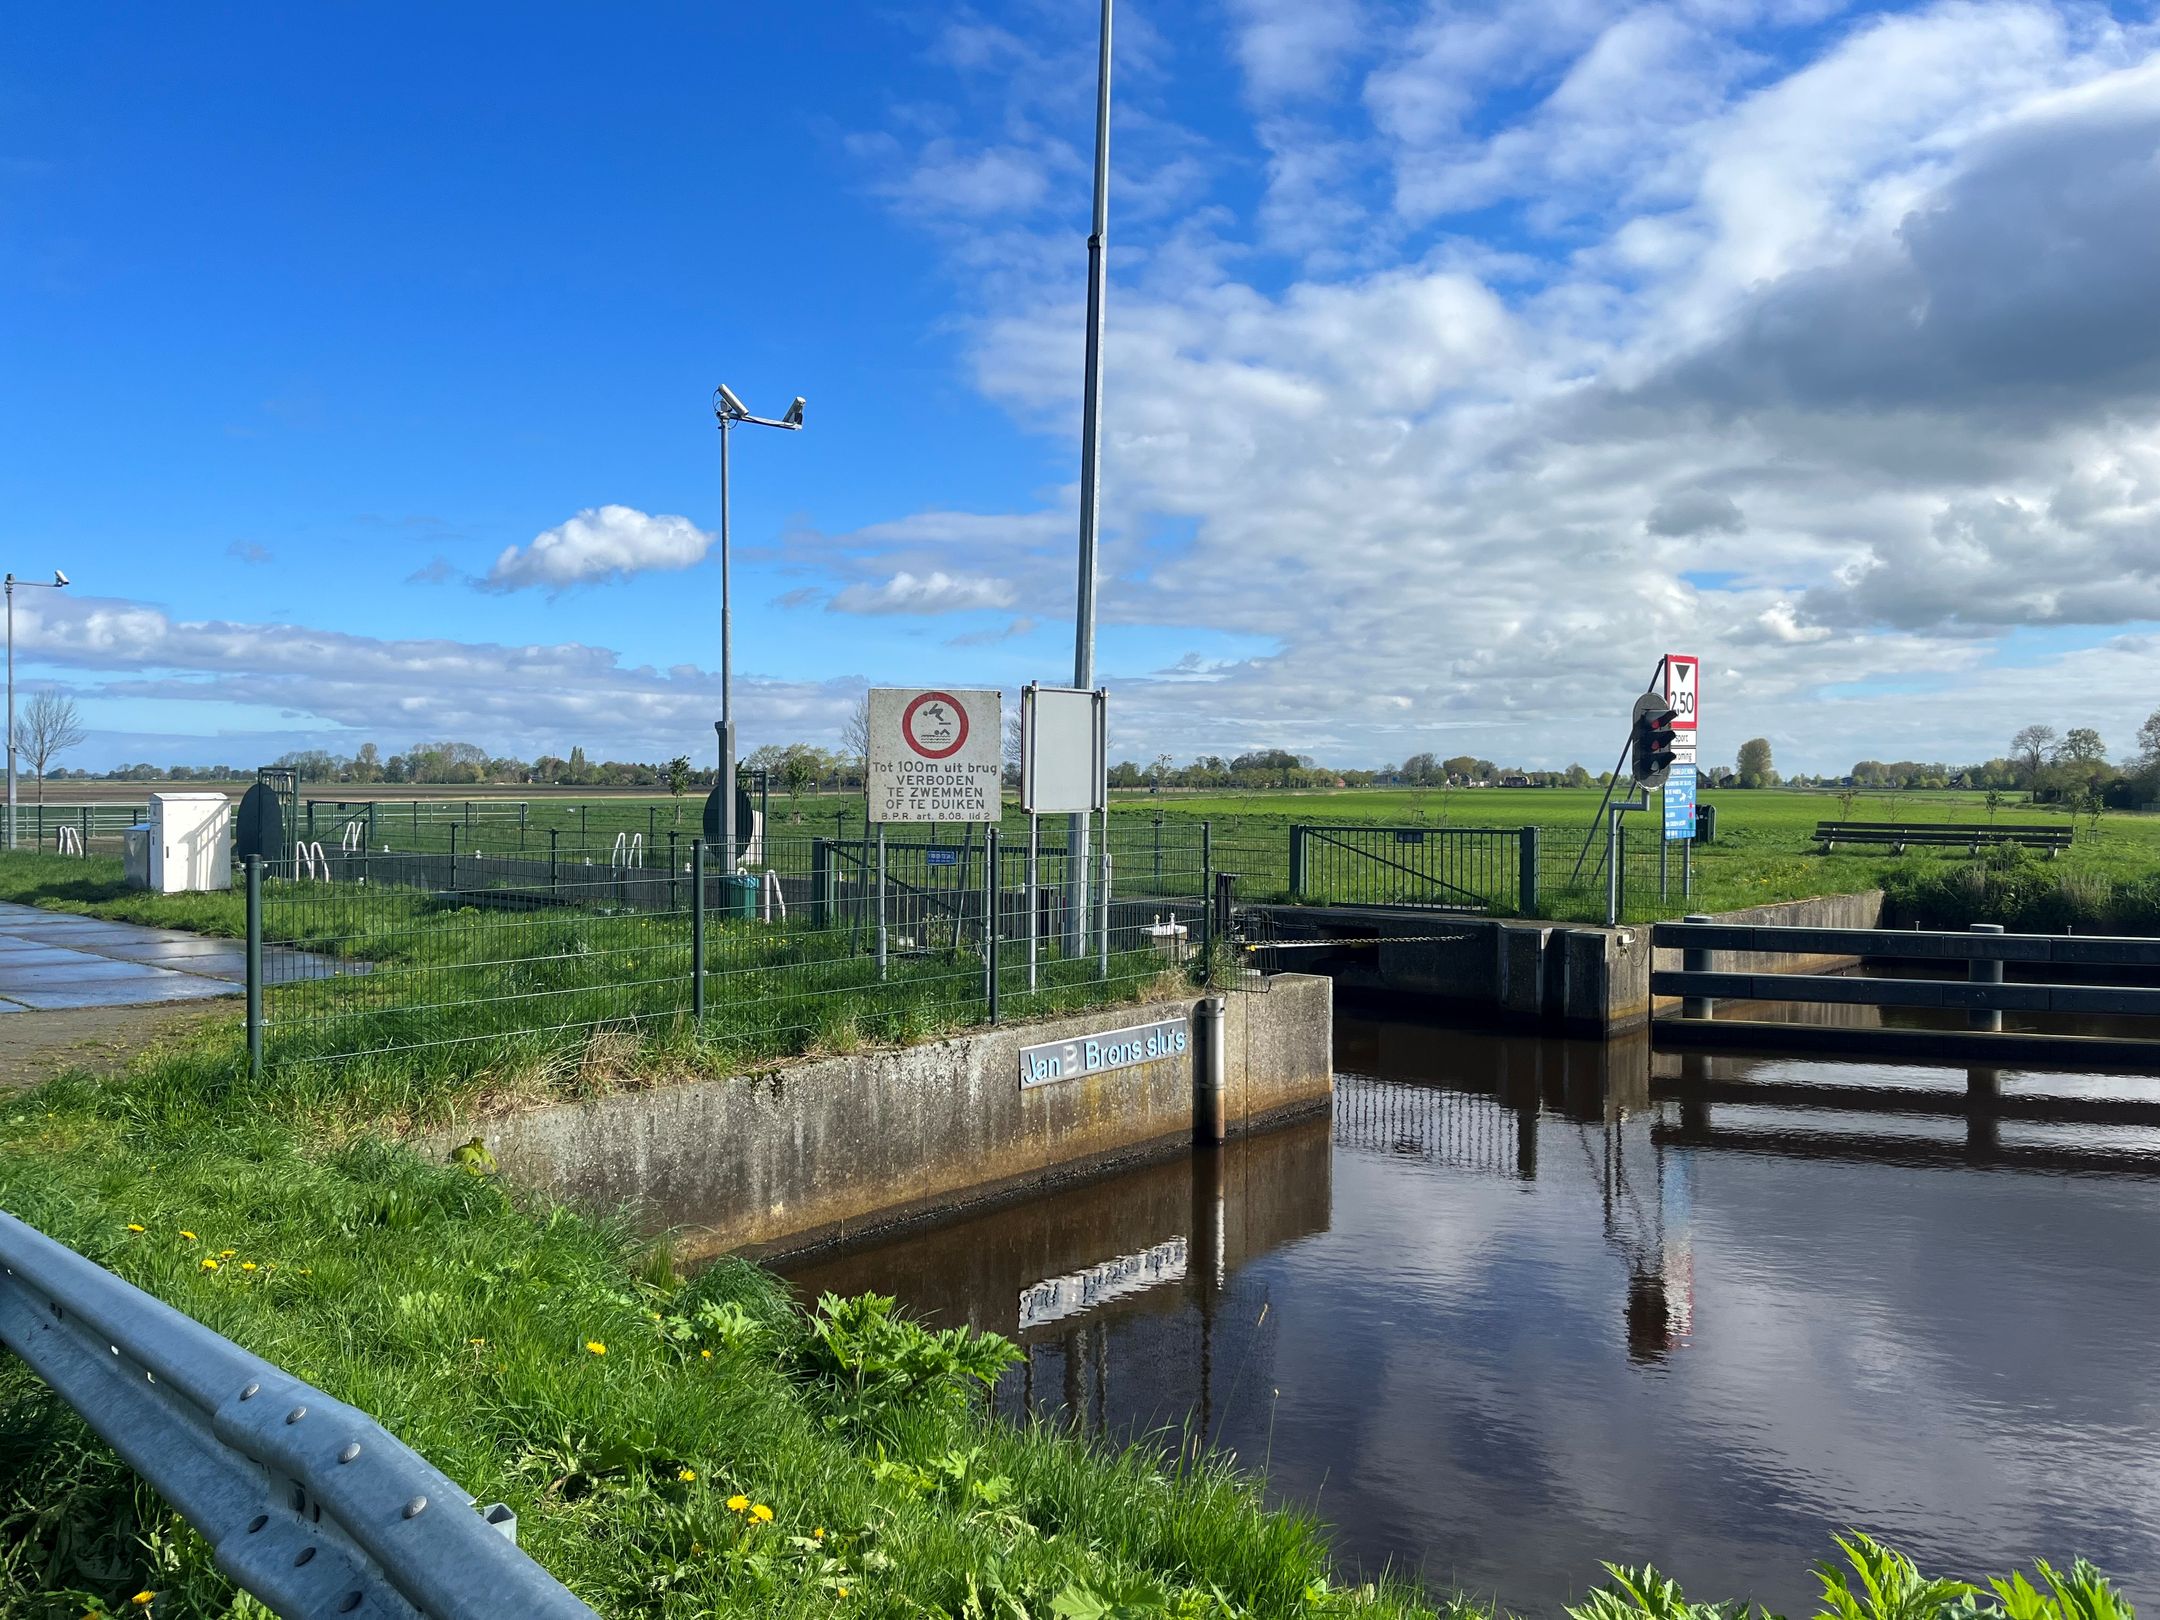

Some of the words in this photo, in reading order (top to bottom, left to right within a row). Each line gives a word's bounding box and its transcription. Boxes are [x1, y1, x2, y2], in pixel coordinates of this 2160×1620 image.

[1670, 691, 1694, 715] 2,50
[873, 762, 893, 773] Tot
[898, 761, 938, 773] 100m
[944, 762, 962, 773] uit
[968, 763, 997, 776] brug
[897, 776, 974, 785] VERBODEN
[887, 787, 905, 797] TE
[910, 787, 983, 797] ZWEMMEN
[886, 799, 903, 809] OF
[909, 799, 926, 809] TE
[932, 799, 985, 809] DUIKEN
[881, 812, 912, 820] B.P.R.
[916, 812, 934, 820] art.
[969, 812, 981, 820] lid
[984, 812, 990, 820] 2
[1024, 1052, 1060, 1084] Jan
[1084, 1041, 1142, 1070] Brons
[1146, 1028, 1186, 1058] sluis
